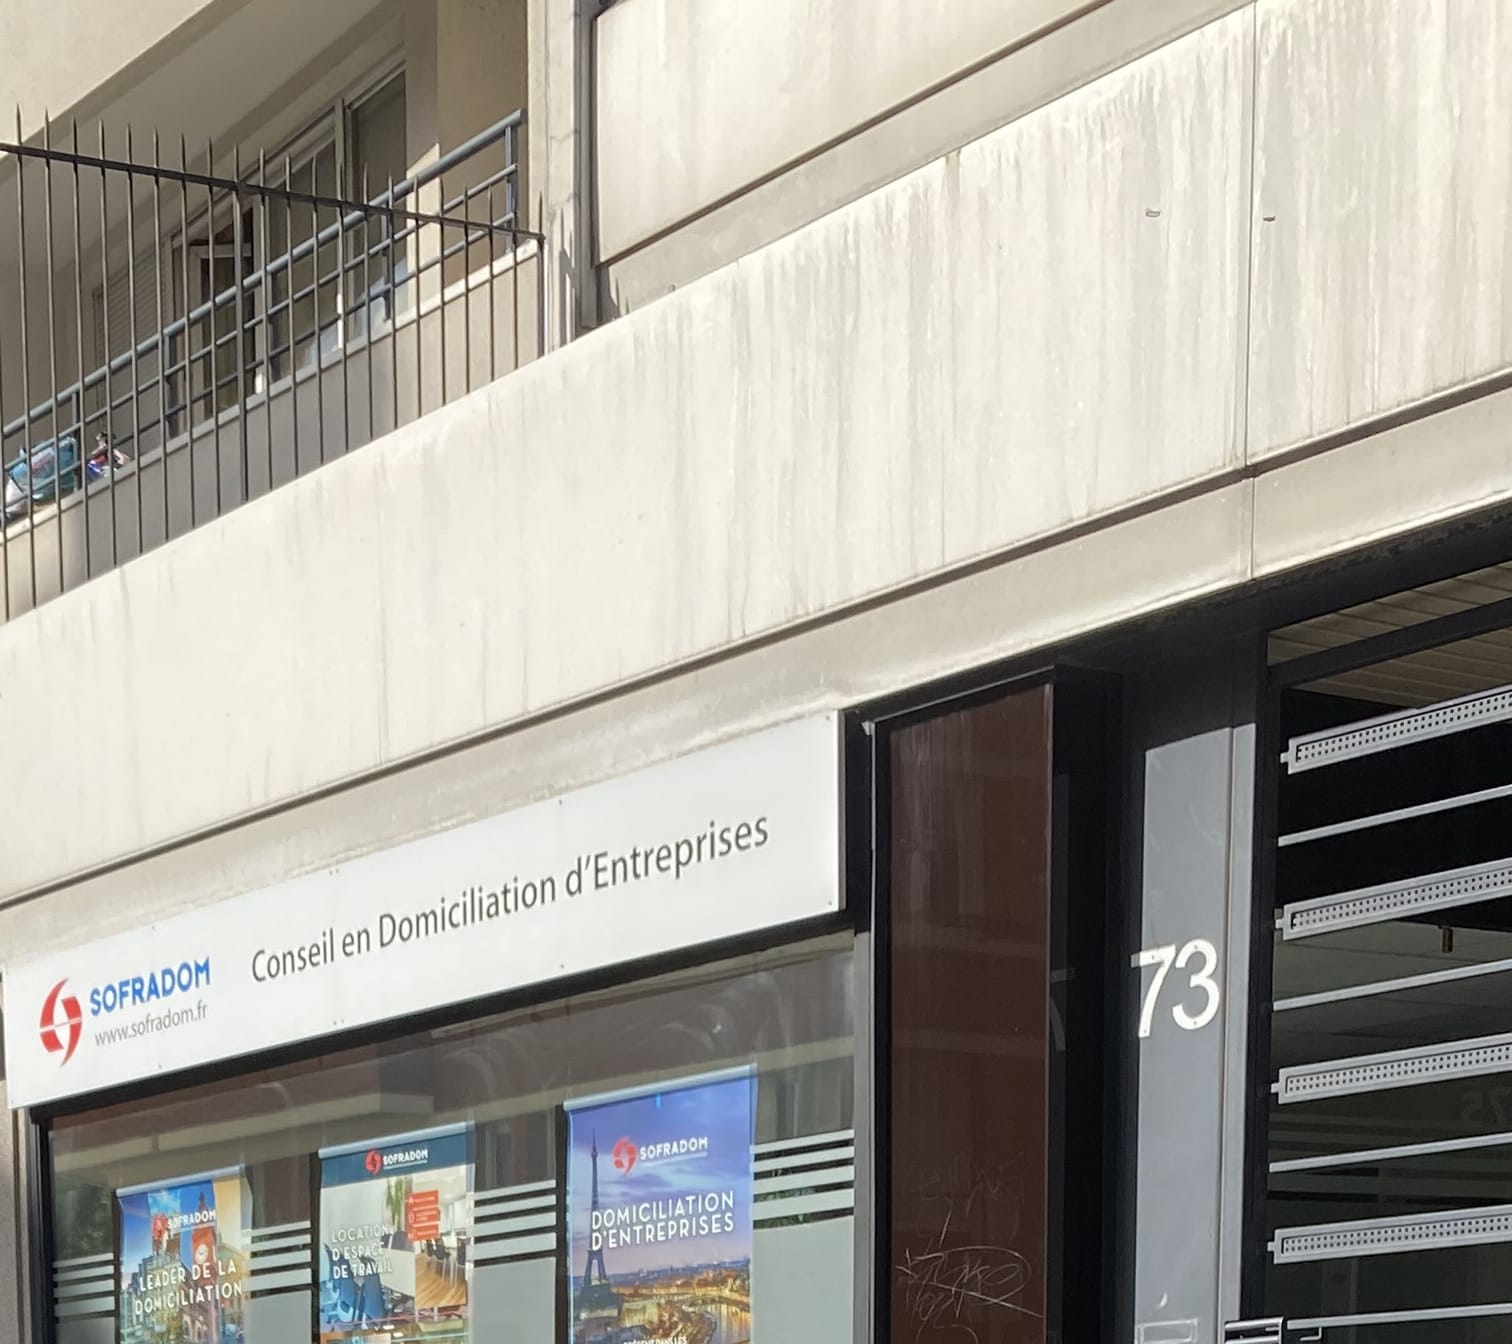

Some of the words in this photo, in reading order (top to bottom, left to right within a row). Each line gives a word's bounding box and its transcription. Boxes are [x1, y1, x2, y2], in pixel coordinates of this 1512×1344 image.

[251, 930, 336, 985] Conseil
[341, 926, 372, 958] en
[377, 870, 557, 948] Domiciliation
[563, 814, 770, 898] d'Entreprises
[90, 956, 211, 1017] SOFRADOM
[1131, 940, 1221, 1039] 73
[93, 1000, 209, 1048] www.sofradom.fr
[383, 1148, 429, 1166] SOFRADOM
[639, 1136, 709, 1162] SOFRADOM
[167, 1209, 217, 1229] SOFRADOM
[591, 1190, 735, 1231] DOMICILIATION
[331, 1223, 389, 1243] LOCATION
[591, 1211, 735, 1251] D'ENTREPRISES
[139, 1266, 186, 1292] LEADER
[191, 1262, 211, 1281] DE
[217, 1258, 237, 1276] LA
[332, 1264, 349, 1280] DE
[351, 1256, 393, 1277] TRAVAIL
[134, 1278, 243, 1317] DOMICILIATION
